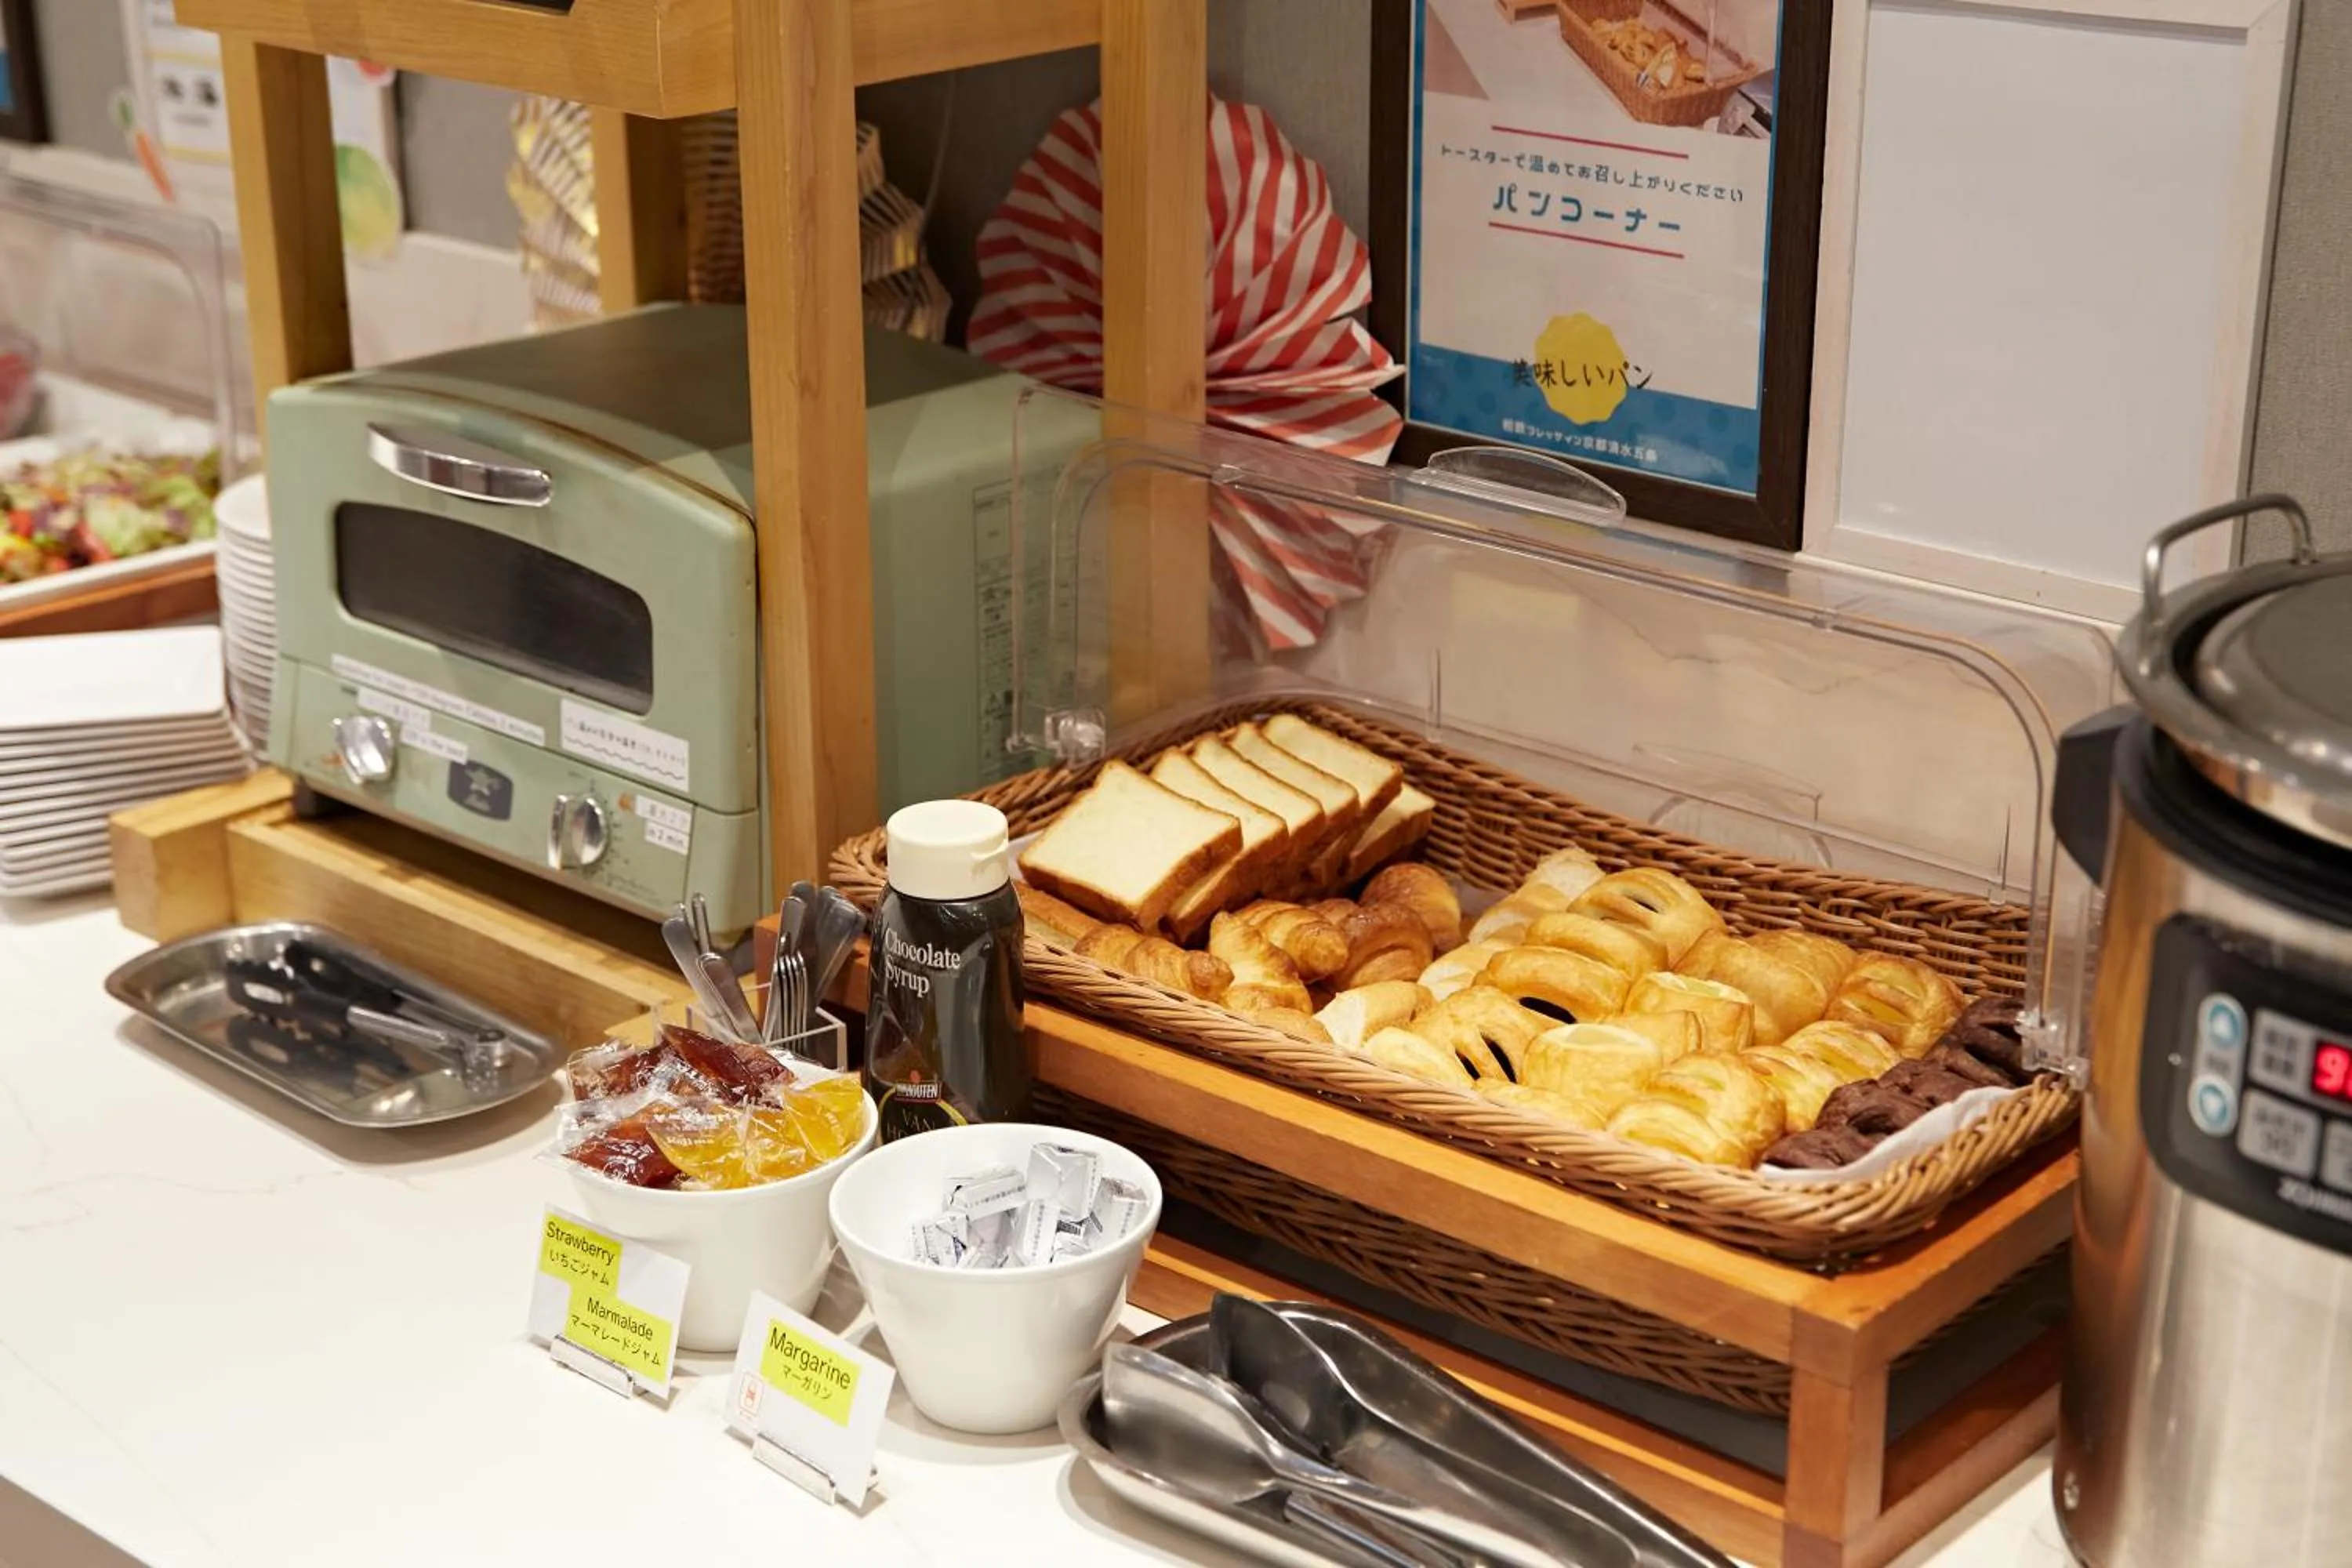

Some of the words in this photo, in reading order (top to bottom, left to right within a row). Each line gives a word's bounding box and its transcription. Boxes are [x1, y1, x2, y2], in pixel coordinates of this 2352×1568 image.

[1441, 143, 1744, 203] トースターで温めてお召し上がりください
[1493, 183, 1681, 232] パンコーナー
[1512, 358, 1653, 390] 美味しいパン
[884, 927, 961, 969] Chocolate
[884, 955, 930, 998] Syrup
[2315, 1044, 2352, 1099] 9
[546, 1221, 615, 1266] Strawberry
[550, 1249, 610, 1287] いちごジャム
[571, 1314, 662, 1367] マーマレードジャム
[586, 1297, 654, 1341] Marmalade
[769, 1327, 851, 1390] Margarine
[782, 1366, 833, 1400] マーガリン
